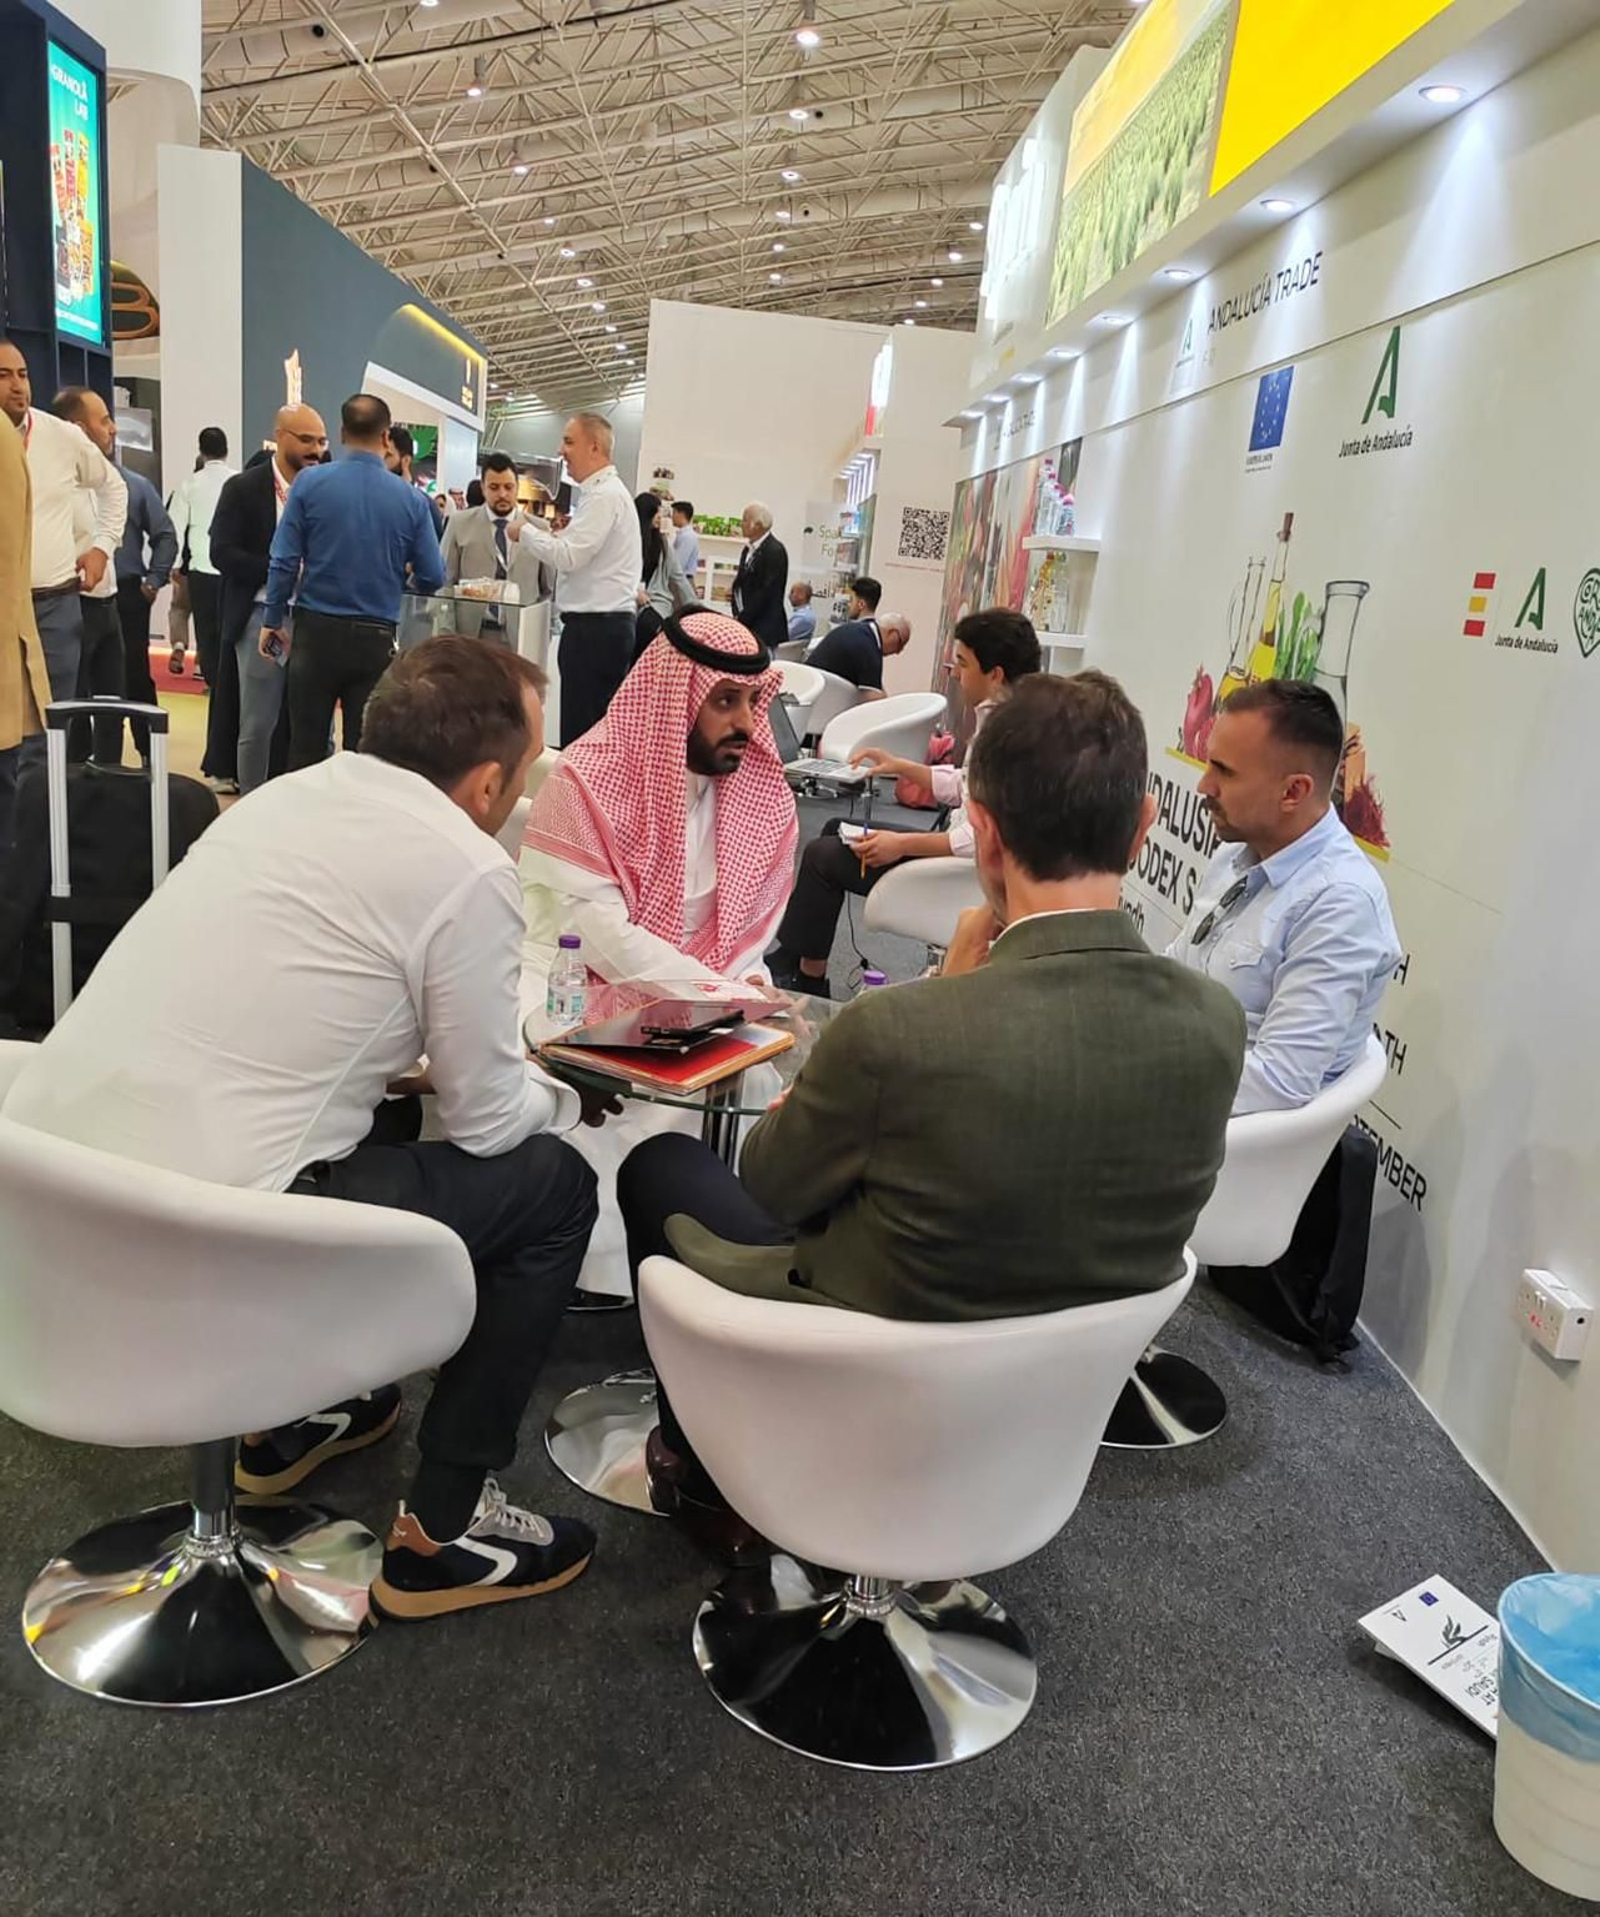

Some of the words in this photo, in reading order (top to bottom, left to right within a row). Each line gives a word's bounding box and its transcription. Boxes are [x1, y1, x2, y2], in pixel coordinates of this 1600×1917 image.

[1206, 272, 1271, 335] ANDALUCÍA
[1275, 251, 1323, 304] TRADE
[1338, 440, 1361, 458] Junta
[1360, 434, 1371, 454] de
[1371, 424, 1413, 452] Andalucía
[1494, 633, 1514, 648] Junta
[1514, 635, 1524, 650] de
[1128, 836, 1184, 905] ODEX
